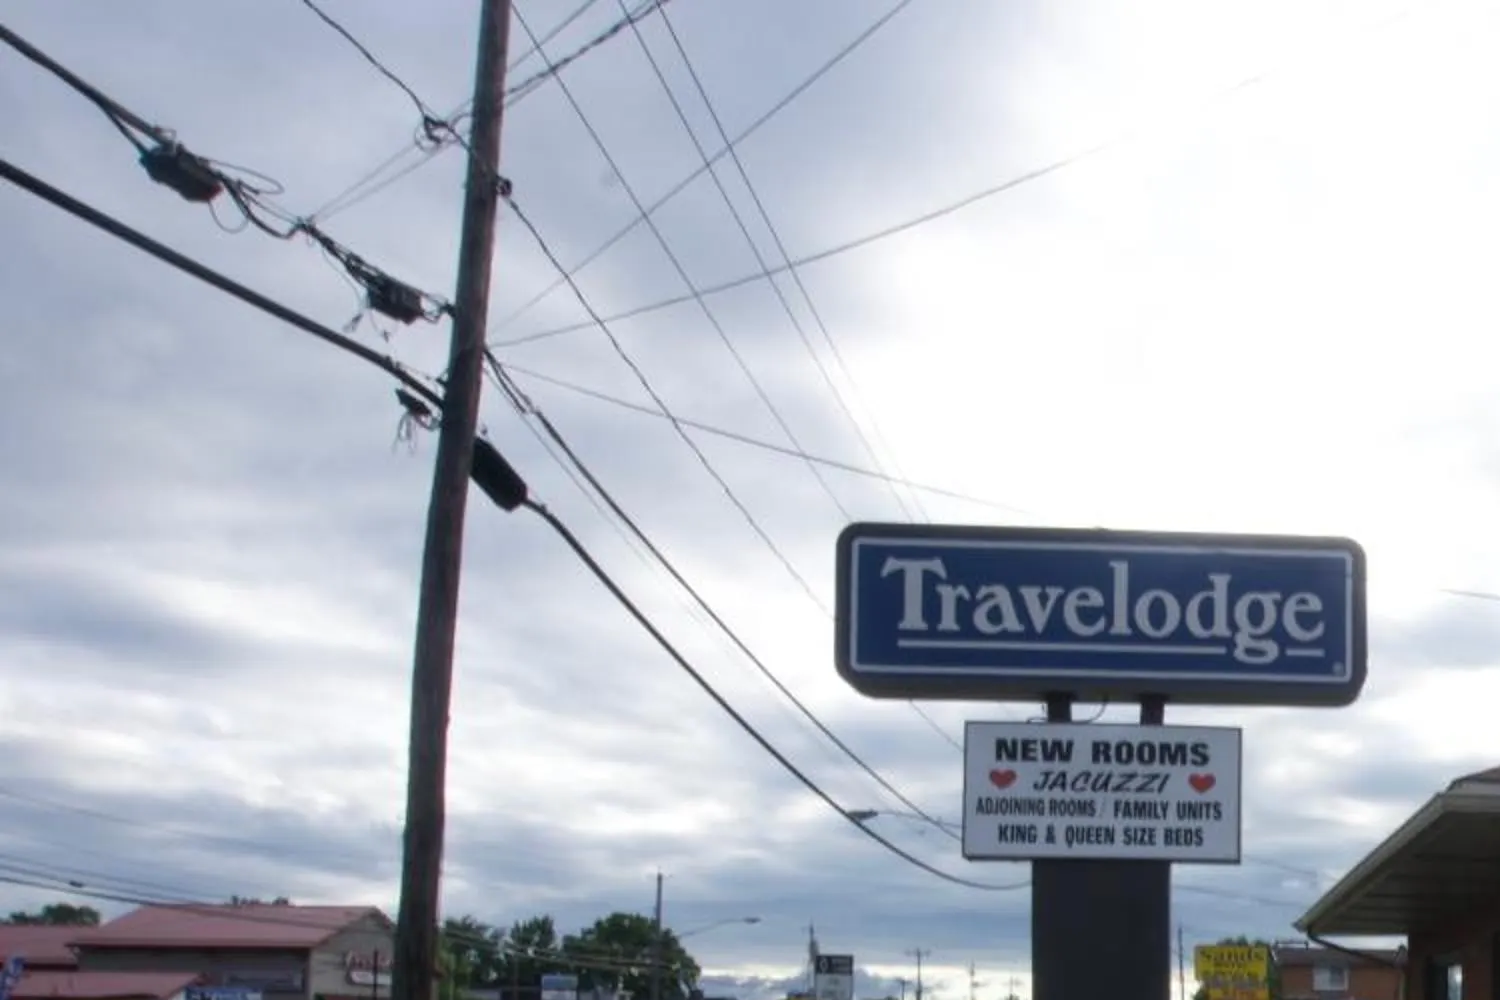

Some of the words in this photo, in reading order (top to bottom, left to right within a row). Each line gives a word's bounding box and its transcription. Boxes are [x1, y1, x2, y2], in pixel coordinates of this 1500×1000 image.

[881, 556, 1326, 664] Travelodge
[995, 738, 1074, 763] NEW
[1092, 740, 1210, 766] ROOMS
[1033, 770, 1171, 793] JACUZZI
[976, 797, 1045, 817] ADJOINING
[1050, 798, 1096, 817] ROOMS
[1114, 800, 1169, 821] FAMILY
[1177, 801, 1222, 821] UNITS
[998, 824, 1038, 844] KING
[1045, 825, 1056, 845] &
[1065, 825, 1115, 848] QUEEN
[1123, 827, 1157, 846] SIZE
[1163, 828, 1204, 847] BEDS
